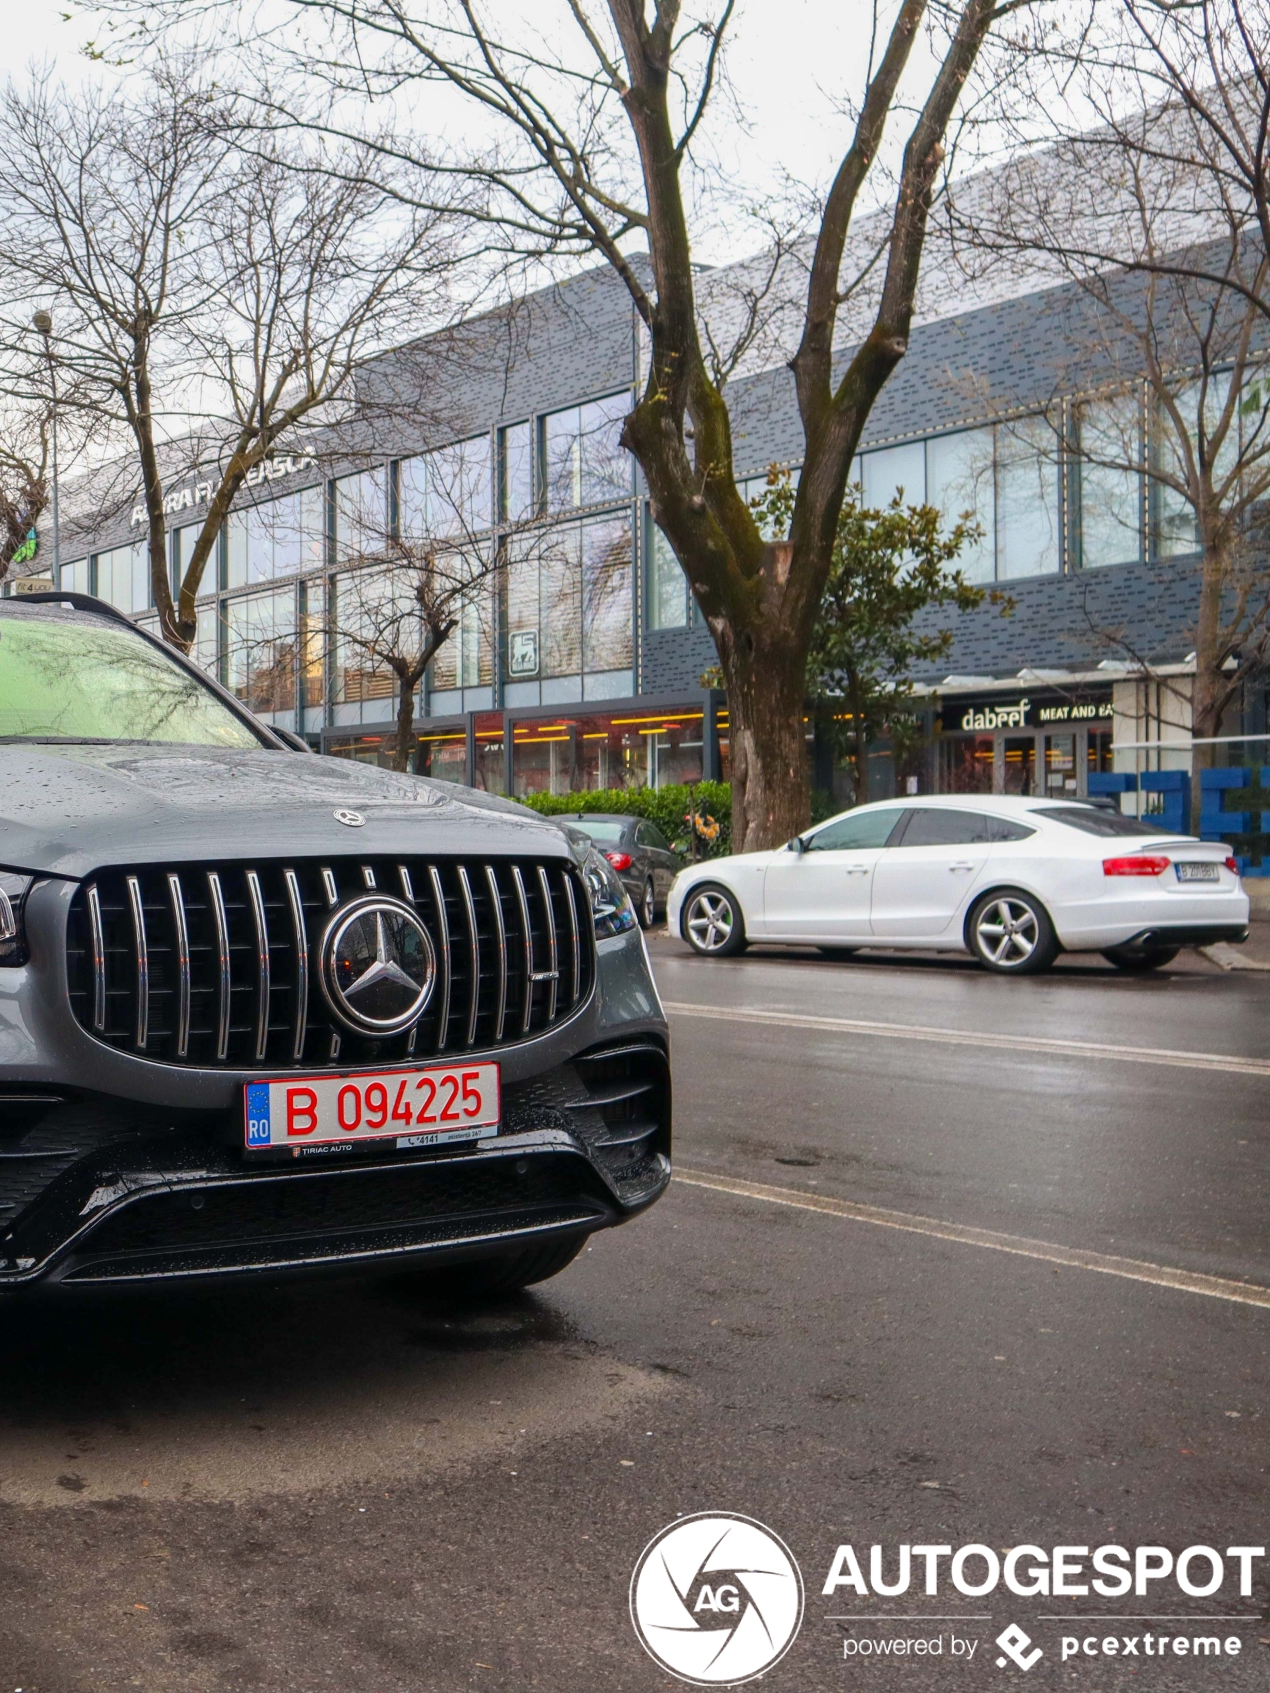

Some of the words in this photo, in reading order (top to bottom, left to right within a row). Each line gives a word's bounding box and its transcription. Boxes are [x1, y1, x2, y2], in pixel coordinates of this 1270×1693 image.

[27, 584, 33, 592] 4
[962, 699, 1030, 731] dabeef
[1040, 706, 1069, 721] MEAT
[1071, 705, 1095, 719] AND
[286, 1087, 318, 1136] B
[337, 1071, 482, 1131] 094225
[249, 1119, 269, 1139] RO
[302, 1146, 329, 1156] TIRIAC
[330, 1144, 352, 1153] AUTO
